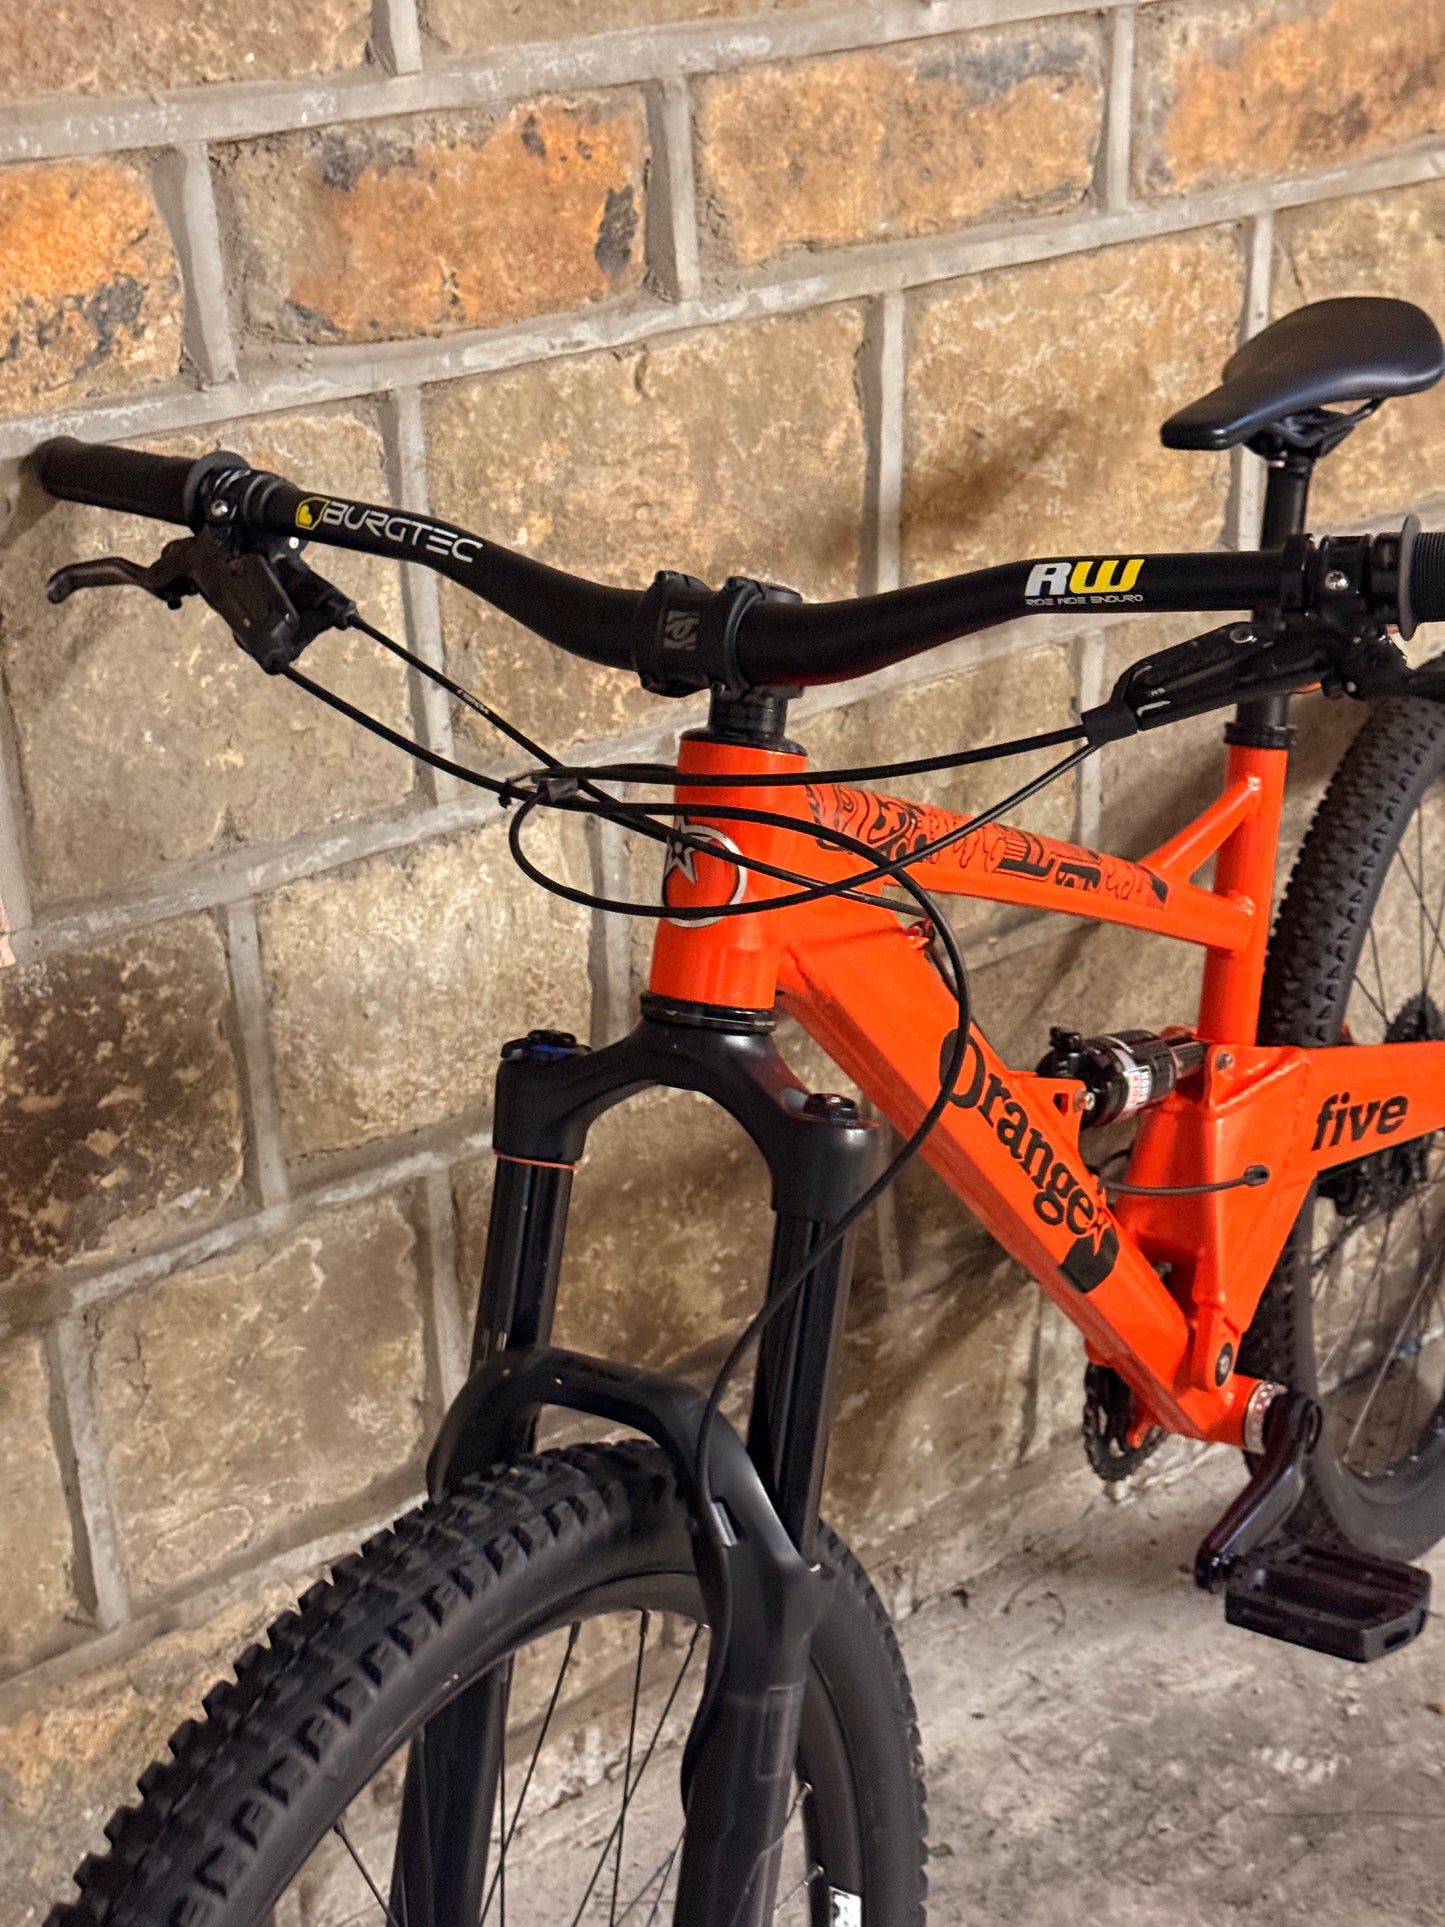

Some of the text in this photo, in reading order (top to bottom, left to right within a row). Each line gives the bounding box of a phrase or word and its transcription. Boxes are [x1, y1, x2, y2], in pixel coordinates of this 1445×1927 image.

[322, 501, 484, 563] BURGTEC
[1090, 594, 1144, 604] ENDURO
[939, 1028, 1095, 1236] Orange
[1311, 1091, 1408, 1151] five
